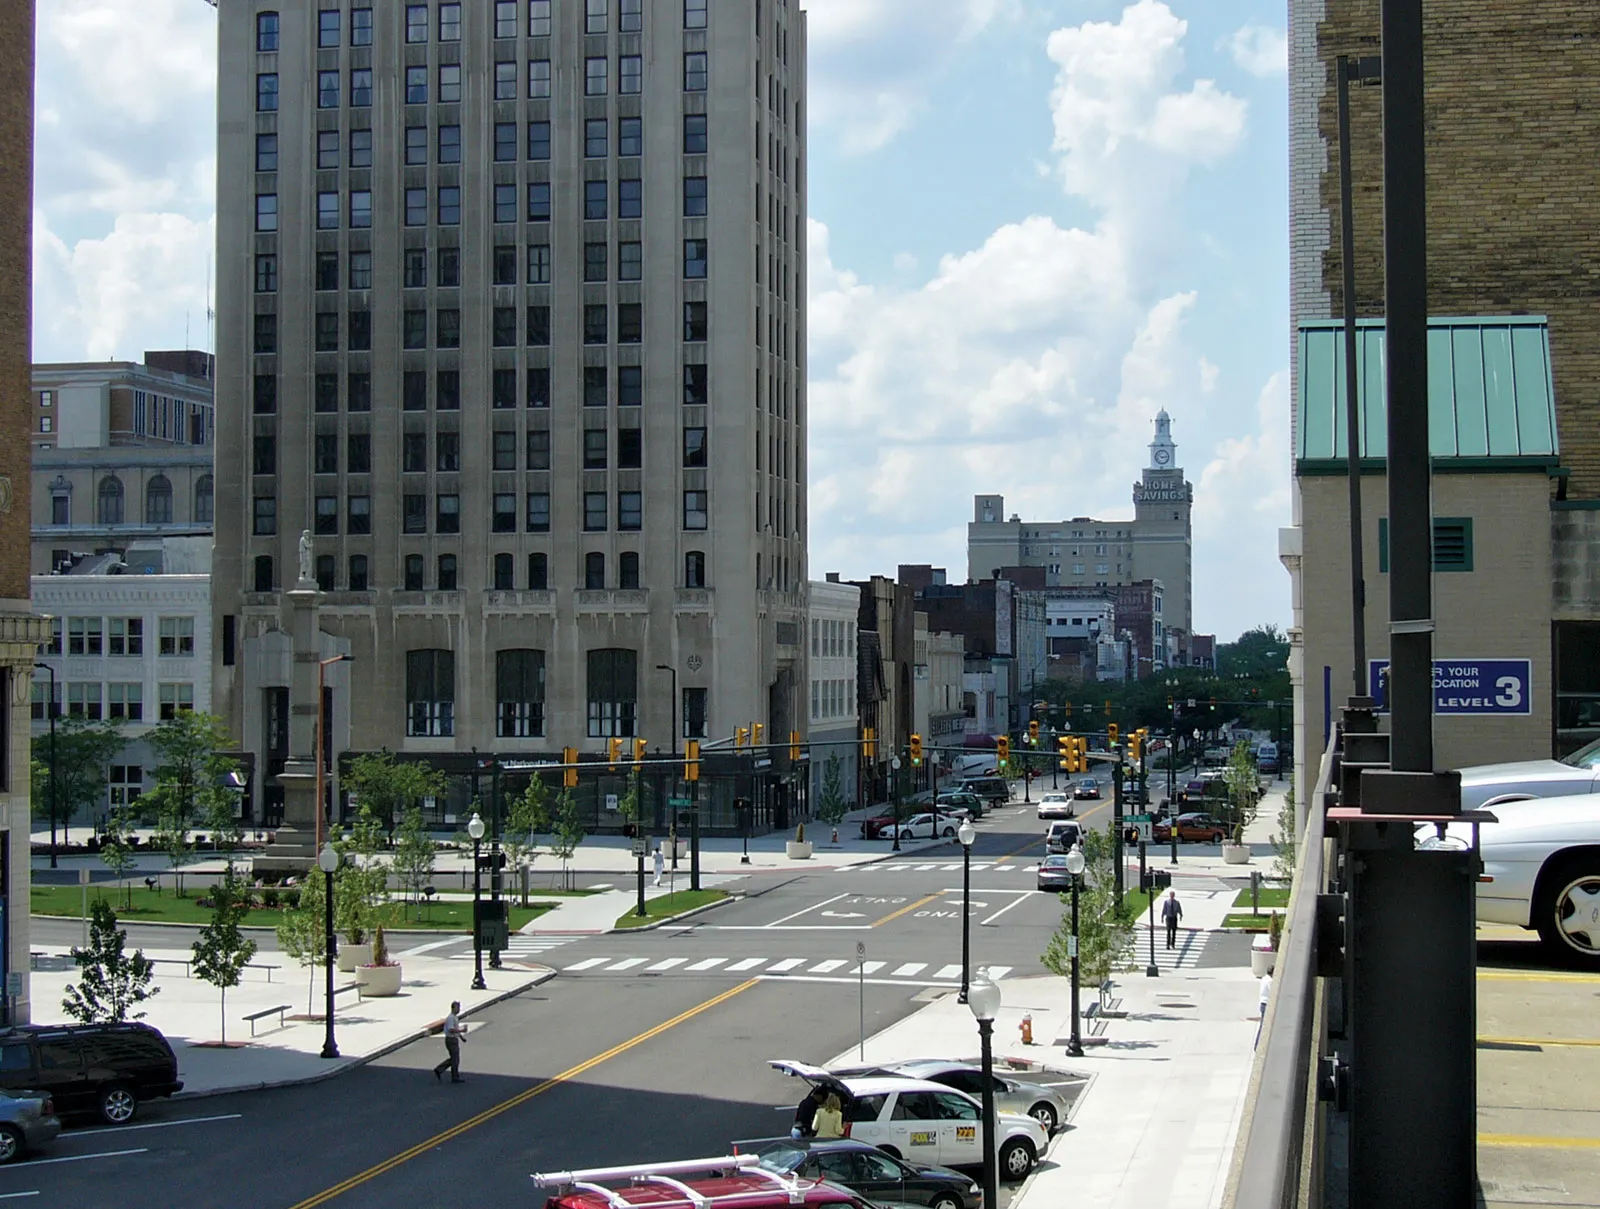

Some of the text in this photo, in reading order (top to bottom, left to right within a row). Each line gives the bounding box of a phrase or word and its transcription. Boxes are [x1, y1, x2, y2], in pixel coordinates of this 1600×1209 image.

[1144, 480, 1176, 490] HOME
[1137, 490, 1184, 500] SAVINGS
[1448, 667, 1479, 676] YOUR
[1438, 676, 1521, 707] LEVEL 3
